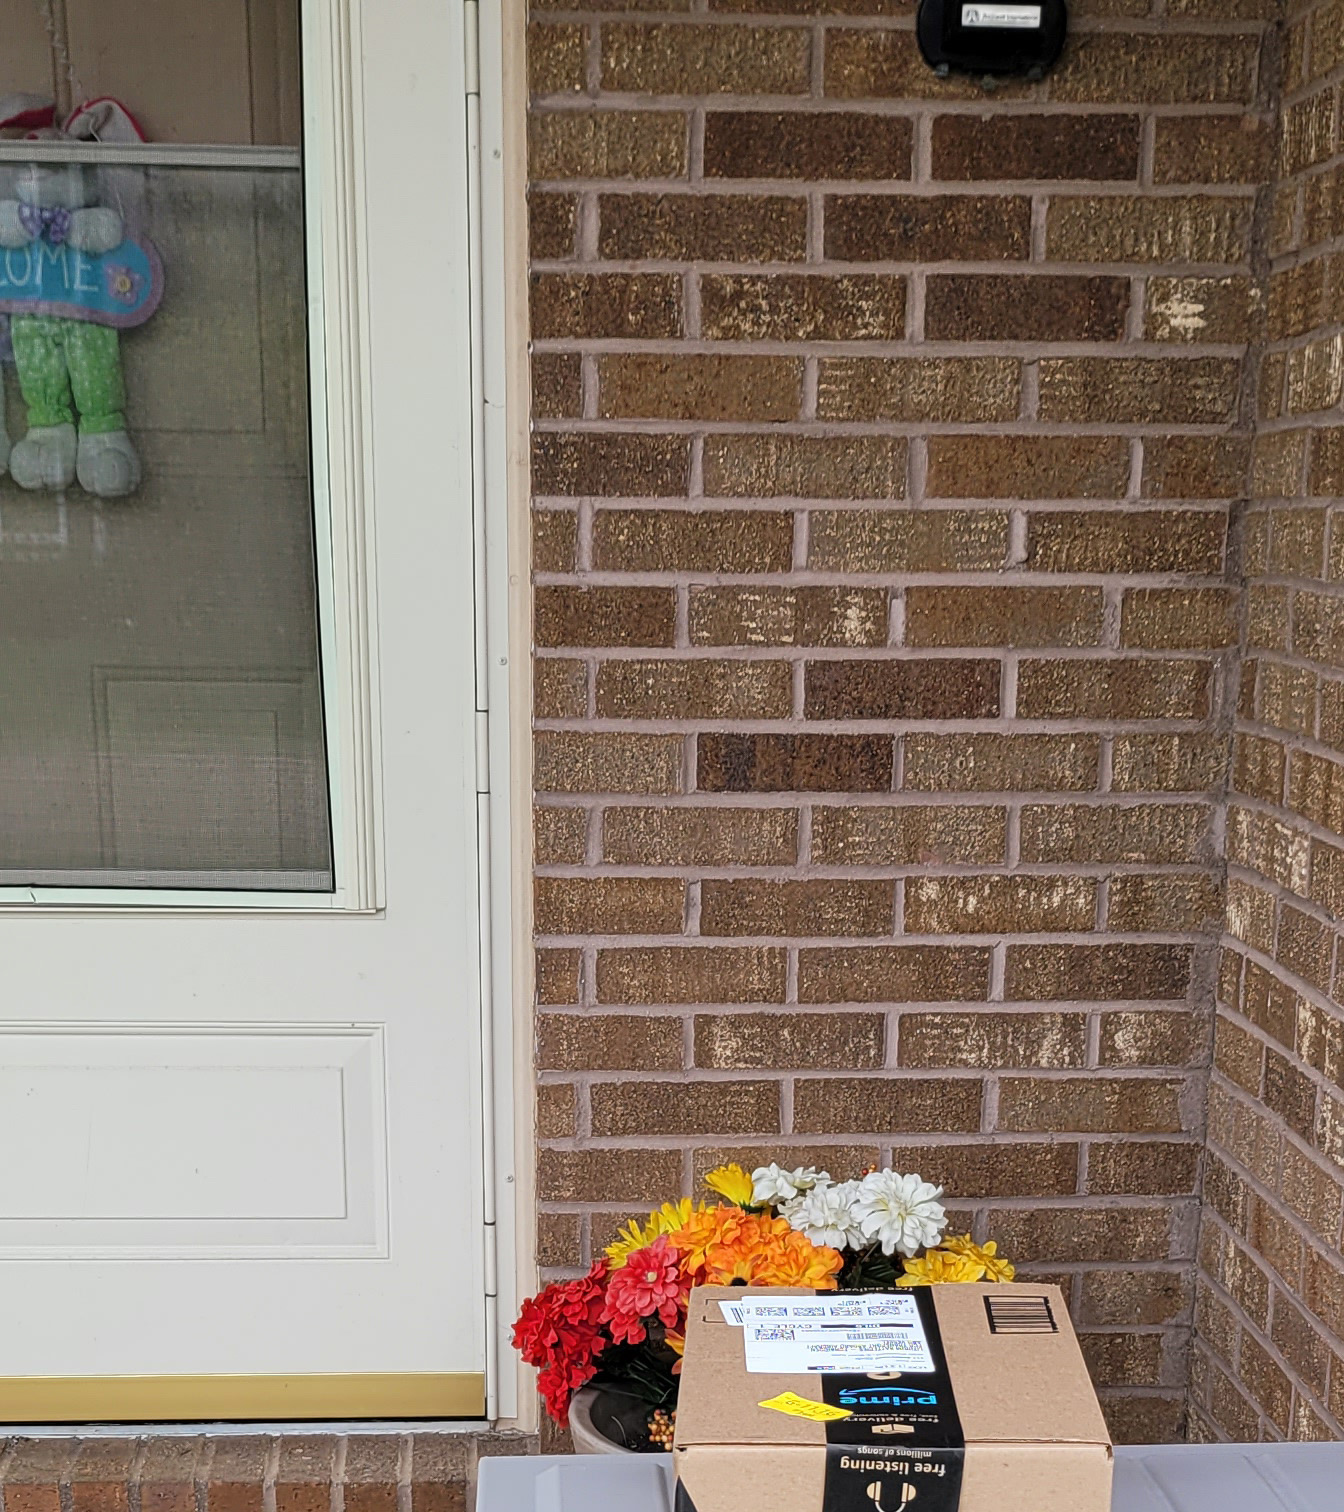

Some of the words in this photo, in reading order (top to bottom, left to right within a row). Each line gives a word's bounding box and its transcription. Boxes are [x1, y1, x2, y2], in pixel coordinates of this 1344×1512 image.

[839, 1395, 937, 1407] prime
[843, 1416, 904, 1424] delivery
[909, 1416, 939, 1424] free
[857, 1446, 884, 1455] songs
[884, 1447, 895, 1457] of
[896, 1448, 932, 1459] millions
[840, 1456, 910, 1476] listening
[914, 1462, 946, 1477] free
